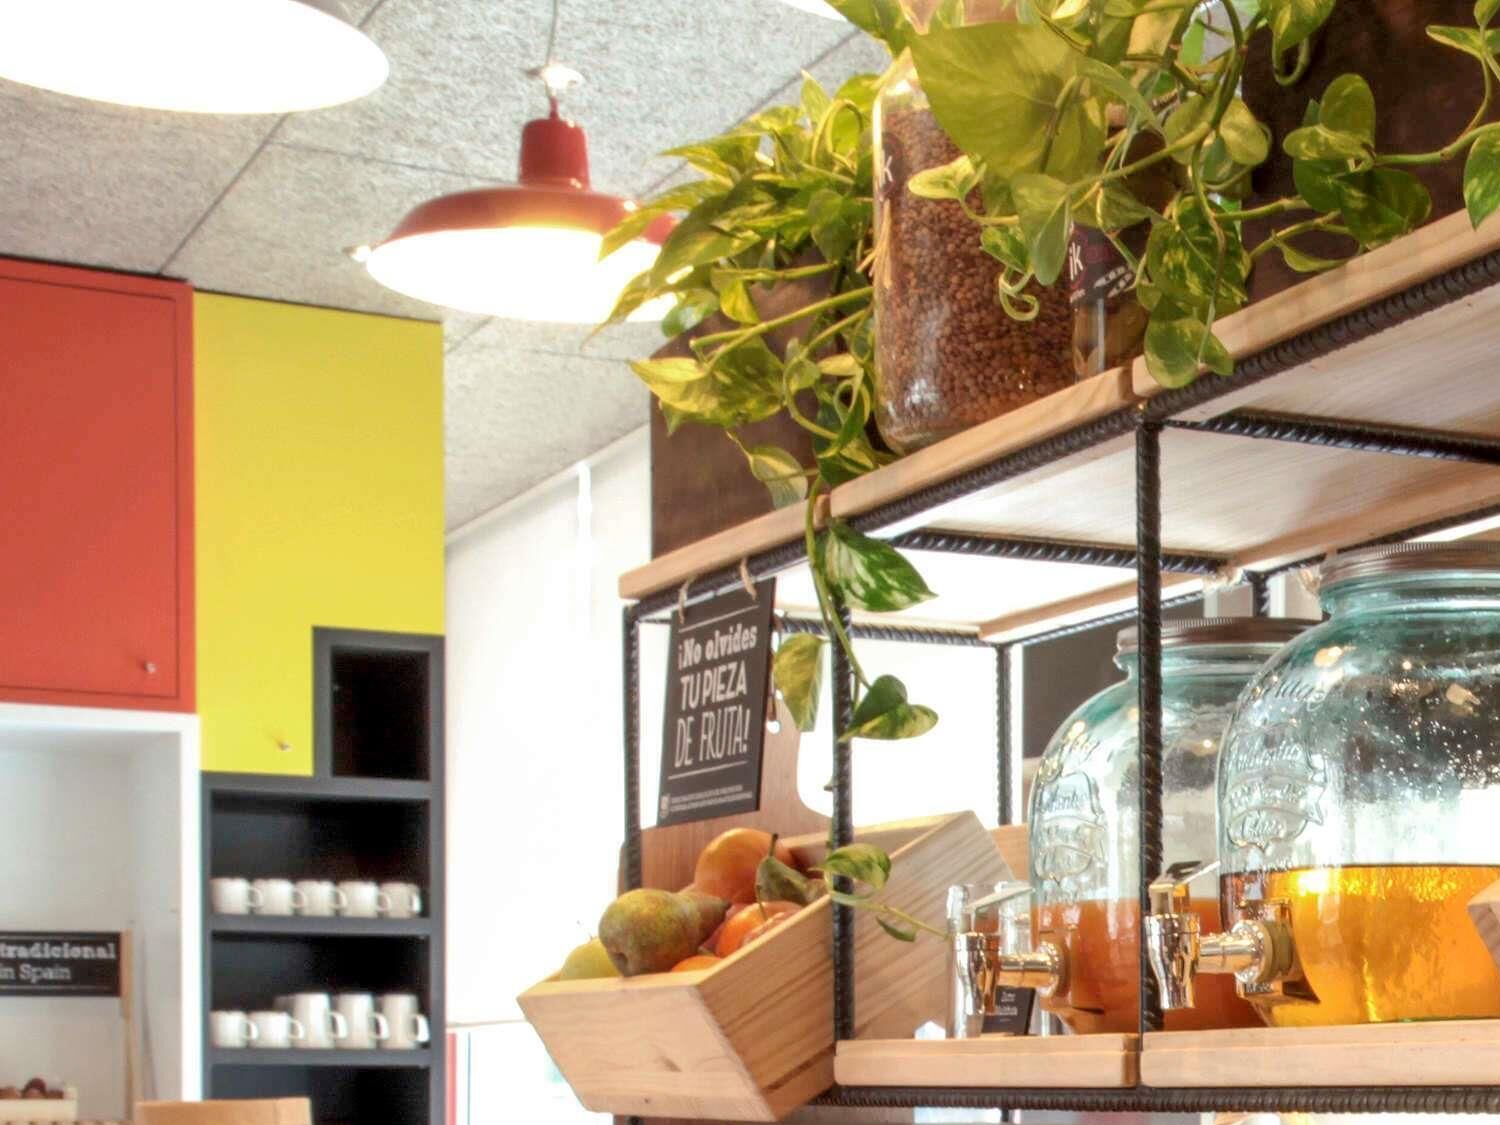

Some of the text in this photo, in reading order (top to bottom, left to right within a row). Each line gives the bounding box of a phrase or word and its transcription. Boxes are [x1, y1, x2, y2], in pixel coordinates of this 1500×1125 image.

[705, 623, 757, 660] olvides
[680, 660, 748, 711] TU PIEZA
[674, 704, 751, 768] DE FRUTA!
[19, 963, 71, 984] Spain
